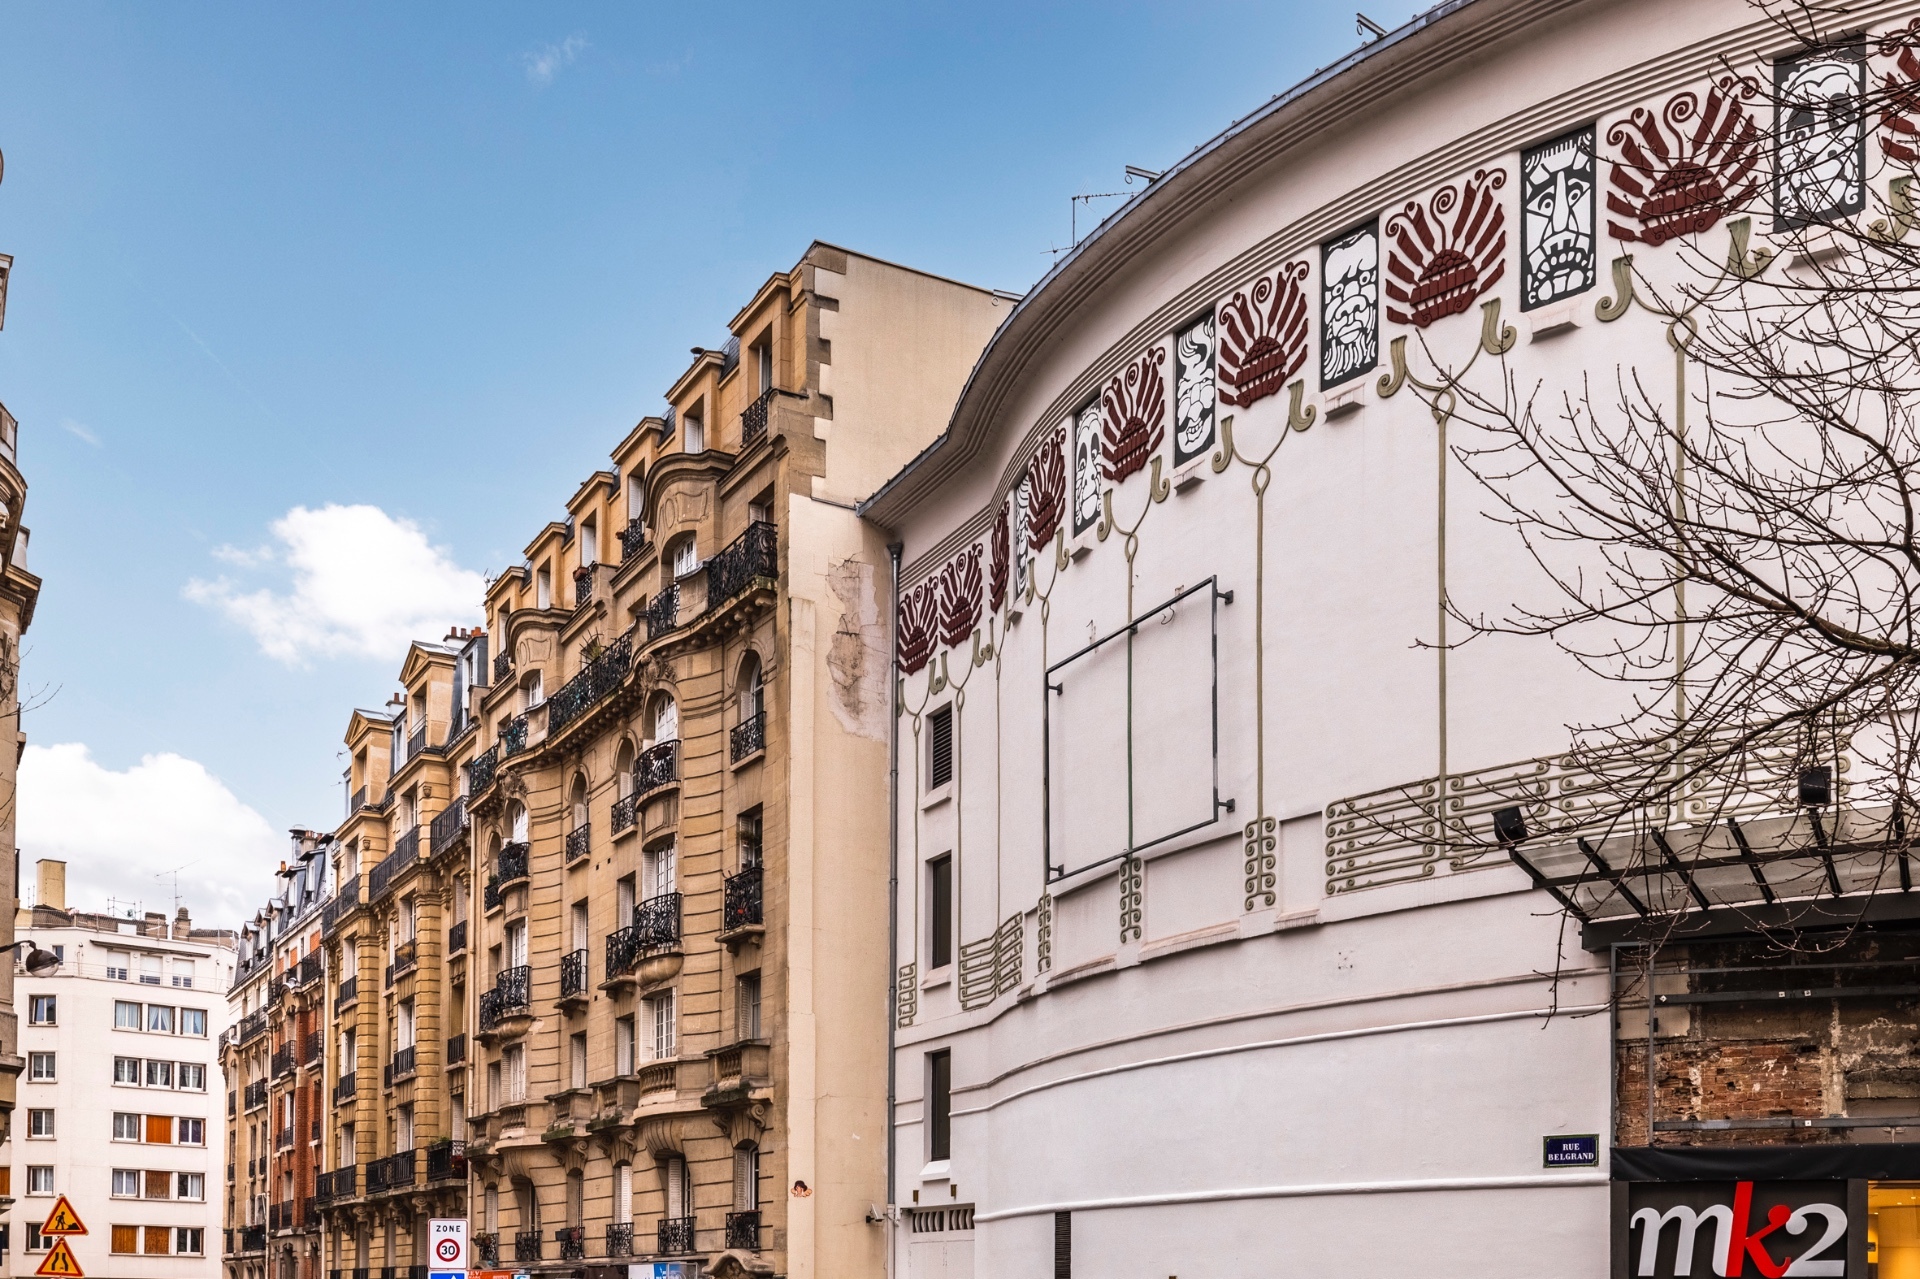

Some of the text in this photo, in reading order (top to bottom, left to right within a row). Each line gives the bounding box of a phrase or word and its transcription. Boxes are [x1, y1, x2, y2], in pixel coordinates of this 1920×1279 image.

[1562, 1143, 1580, 1151] RUE
[1548, 1152, 1594, 1161] BELGRAND
[1630, 1181, 1848, 1279] mk2
[441, 1245, 456, 1255] 30
